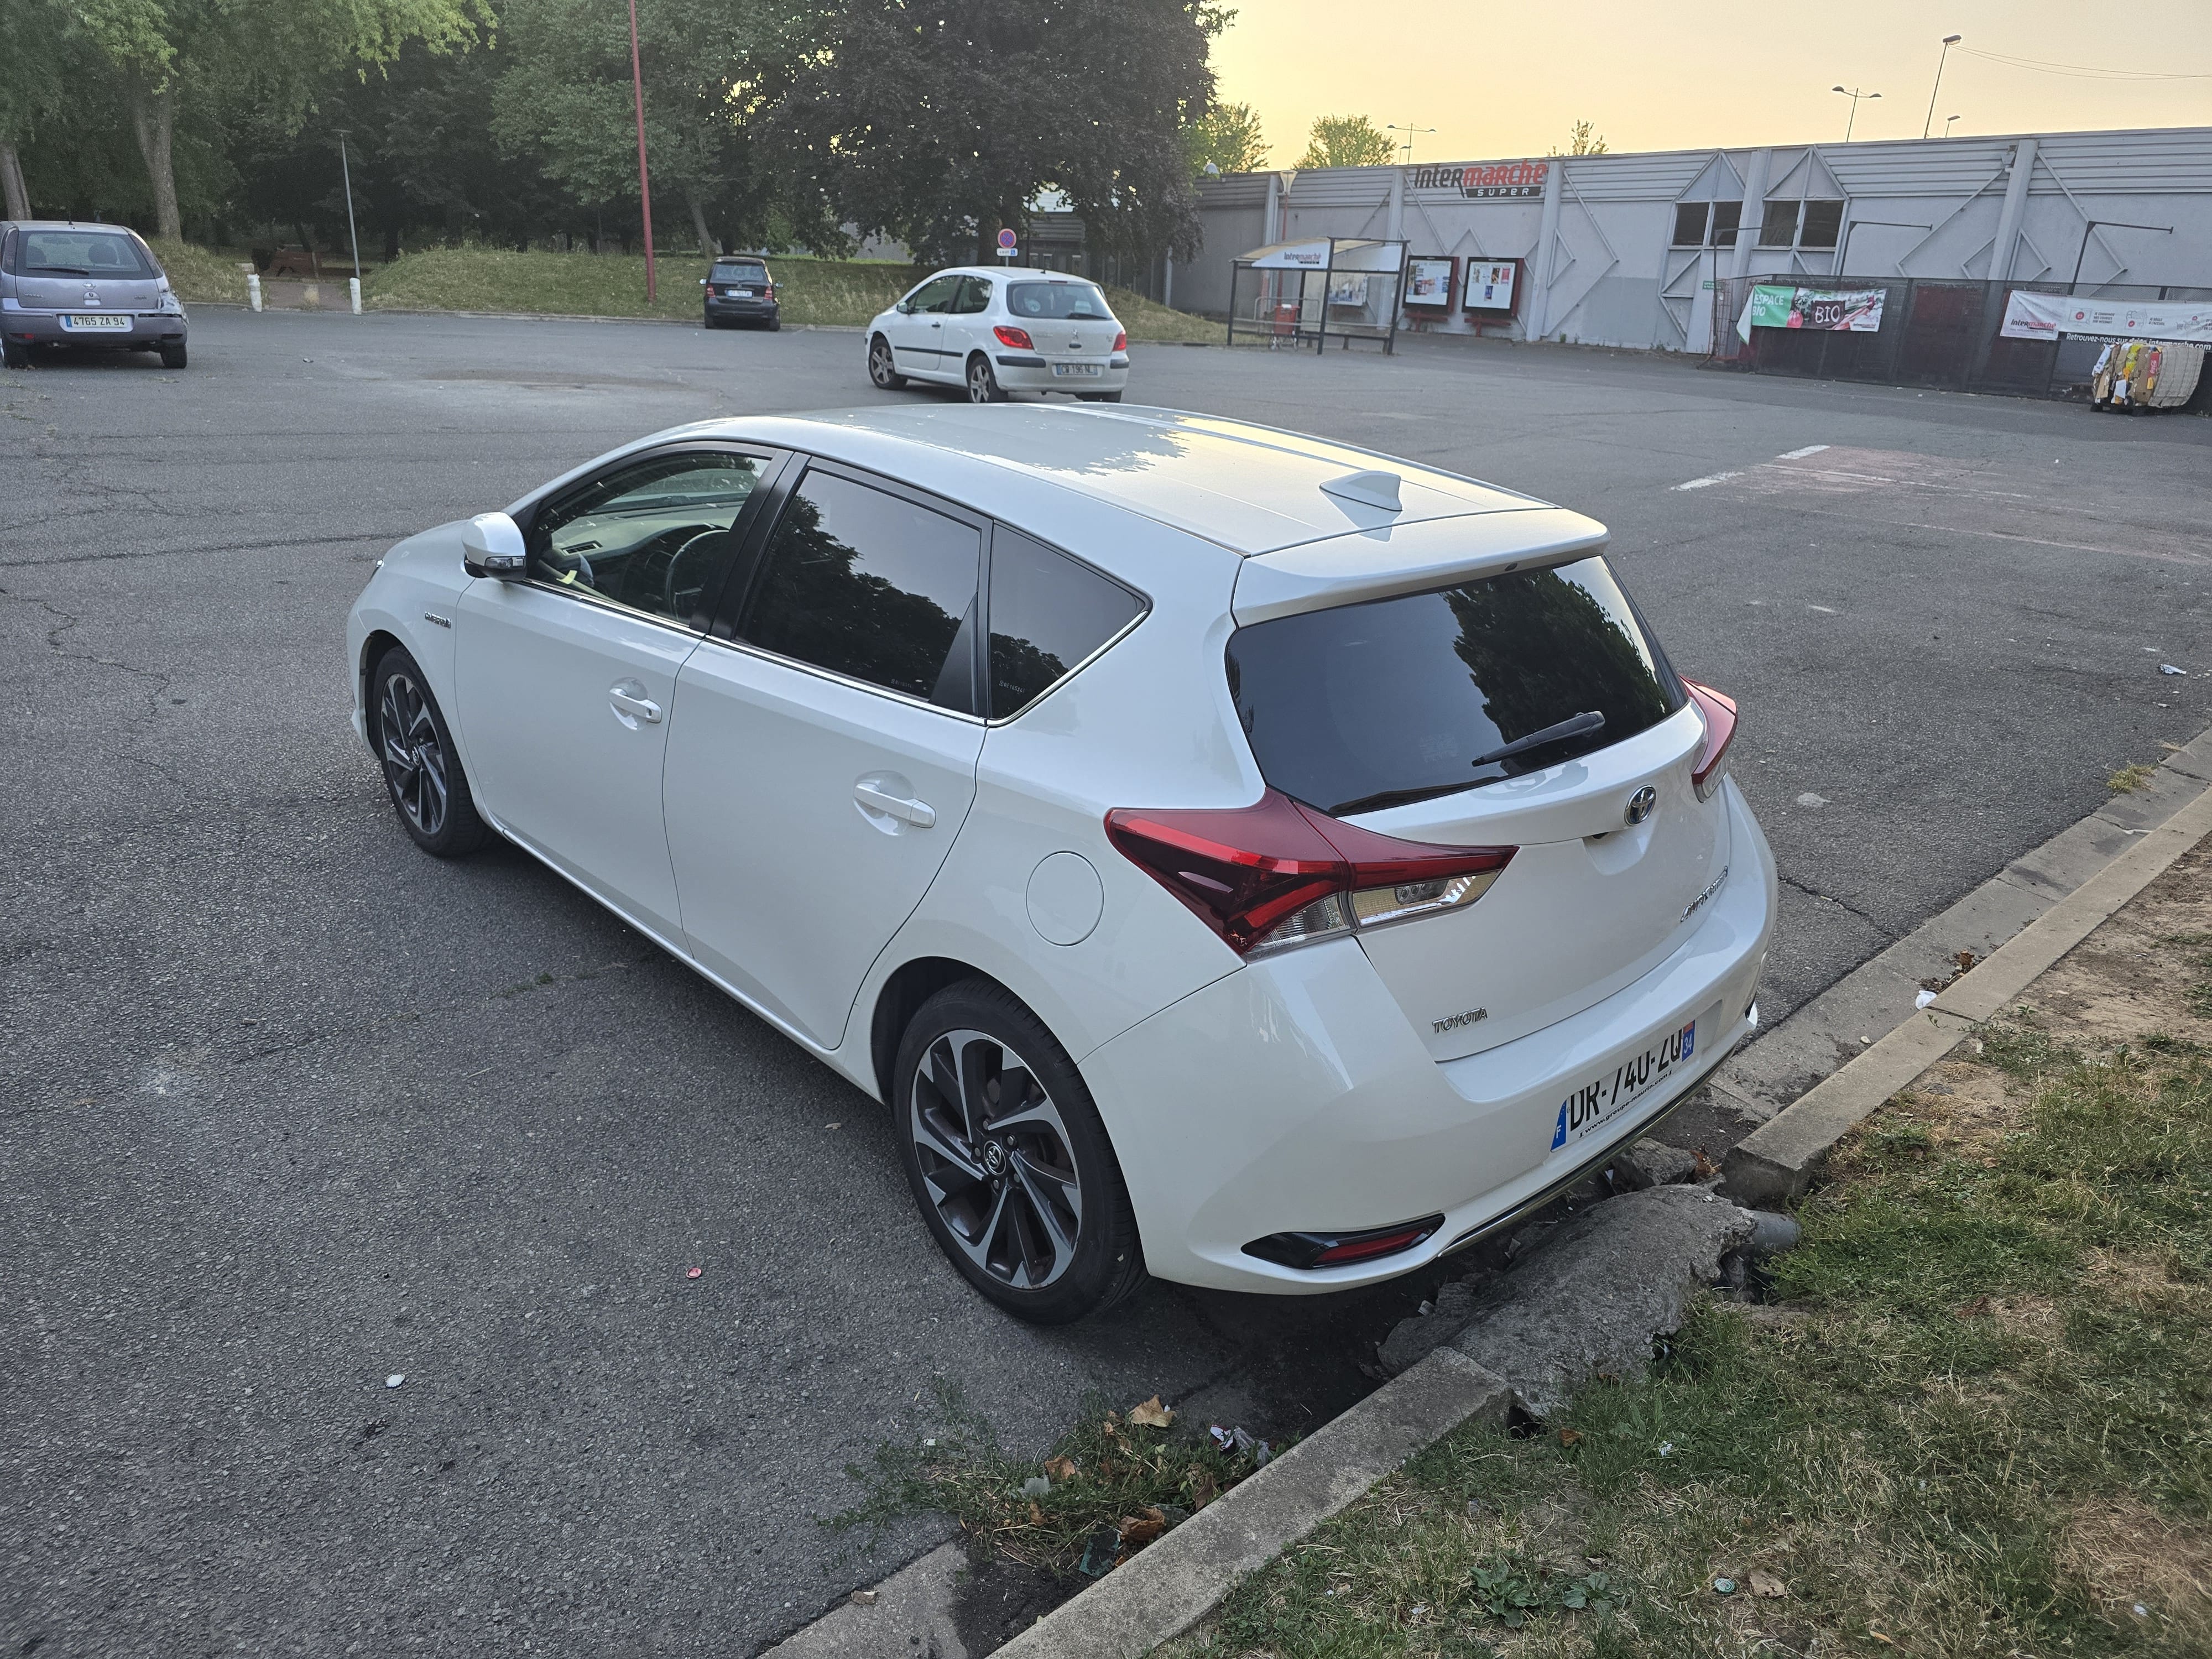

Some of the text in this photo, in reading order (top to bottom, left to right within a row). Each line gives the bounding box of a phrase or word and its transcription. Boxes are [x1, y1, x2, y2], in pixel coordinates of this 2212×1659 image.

[1754, 294, 1784, 305] ESPACE
[1752, 306, 1766, 316] BIO
[1815, 305, 1840, 324] BIO
[74, 317, 97, 325] 4765
[1432, 1006, 1488, 1034] TOYOTA
[1556, 1124, 1562, 1139] F
[1684, 1036, 1692, 1054] 34
[1585, 1073, 1668, 1133] www.groupe-maurin.com
